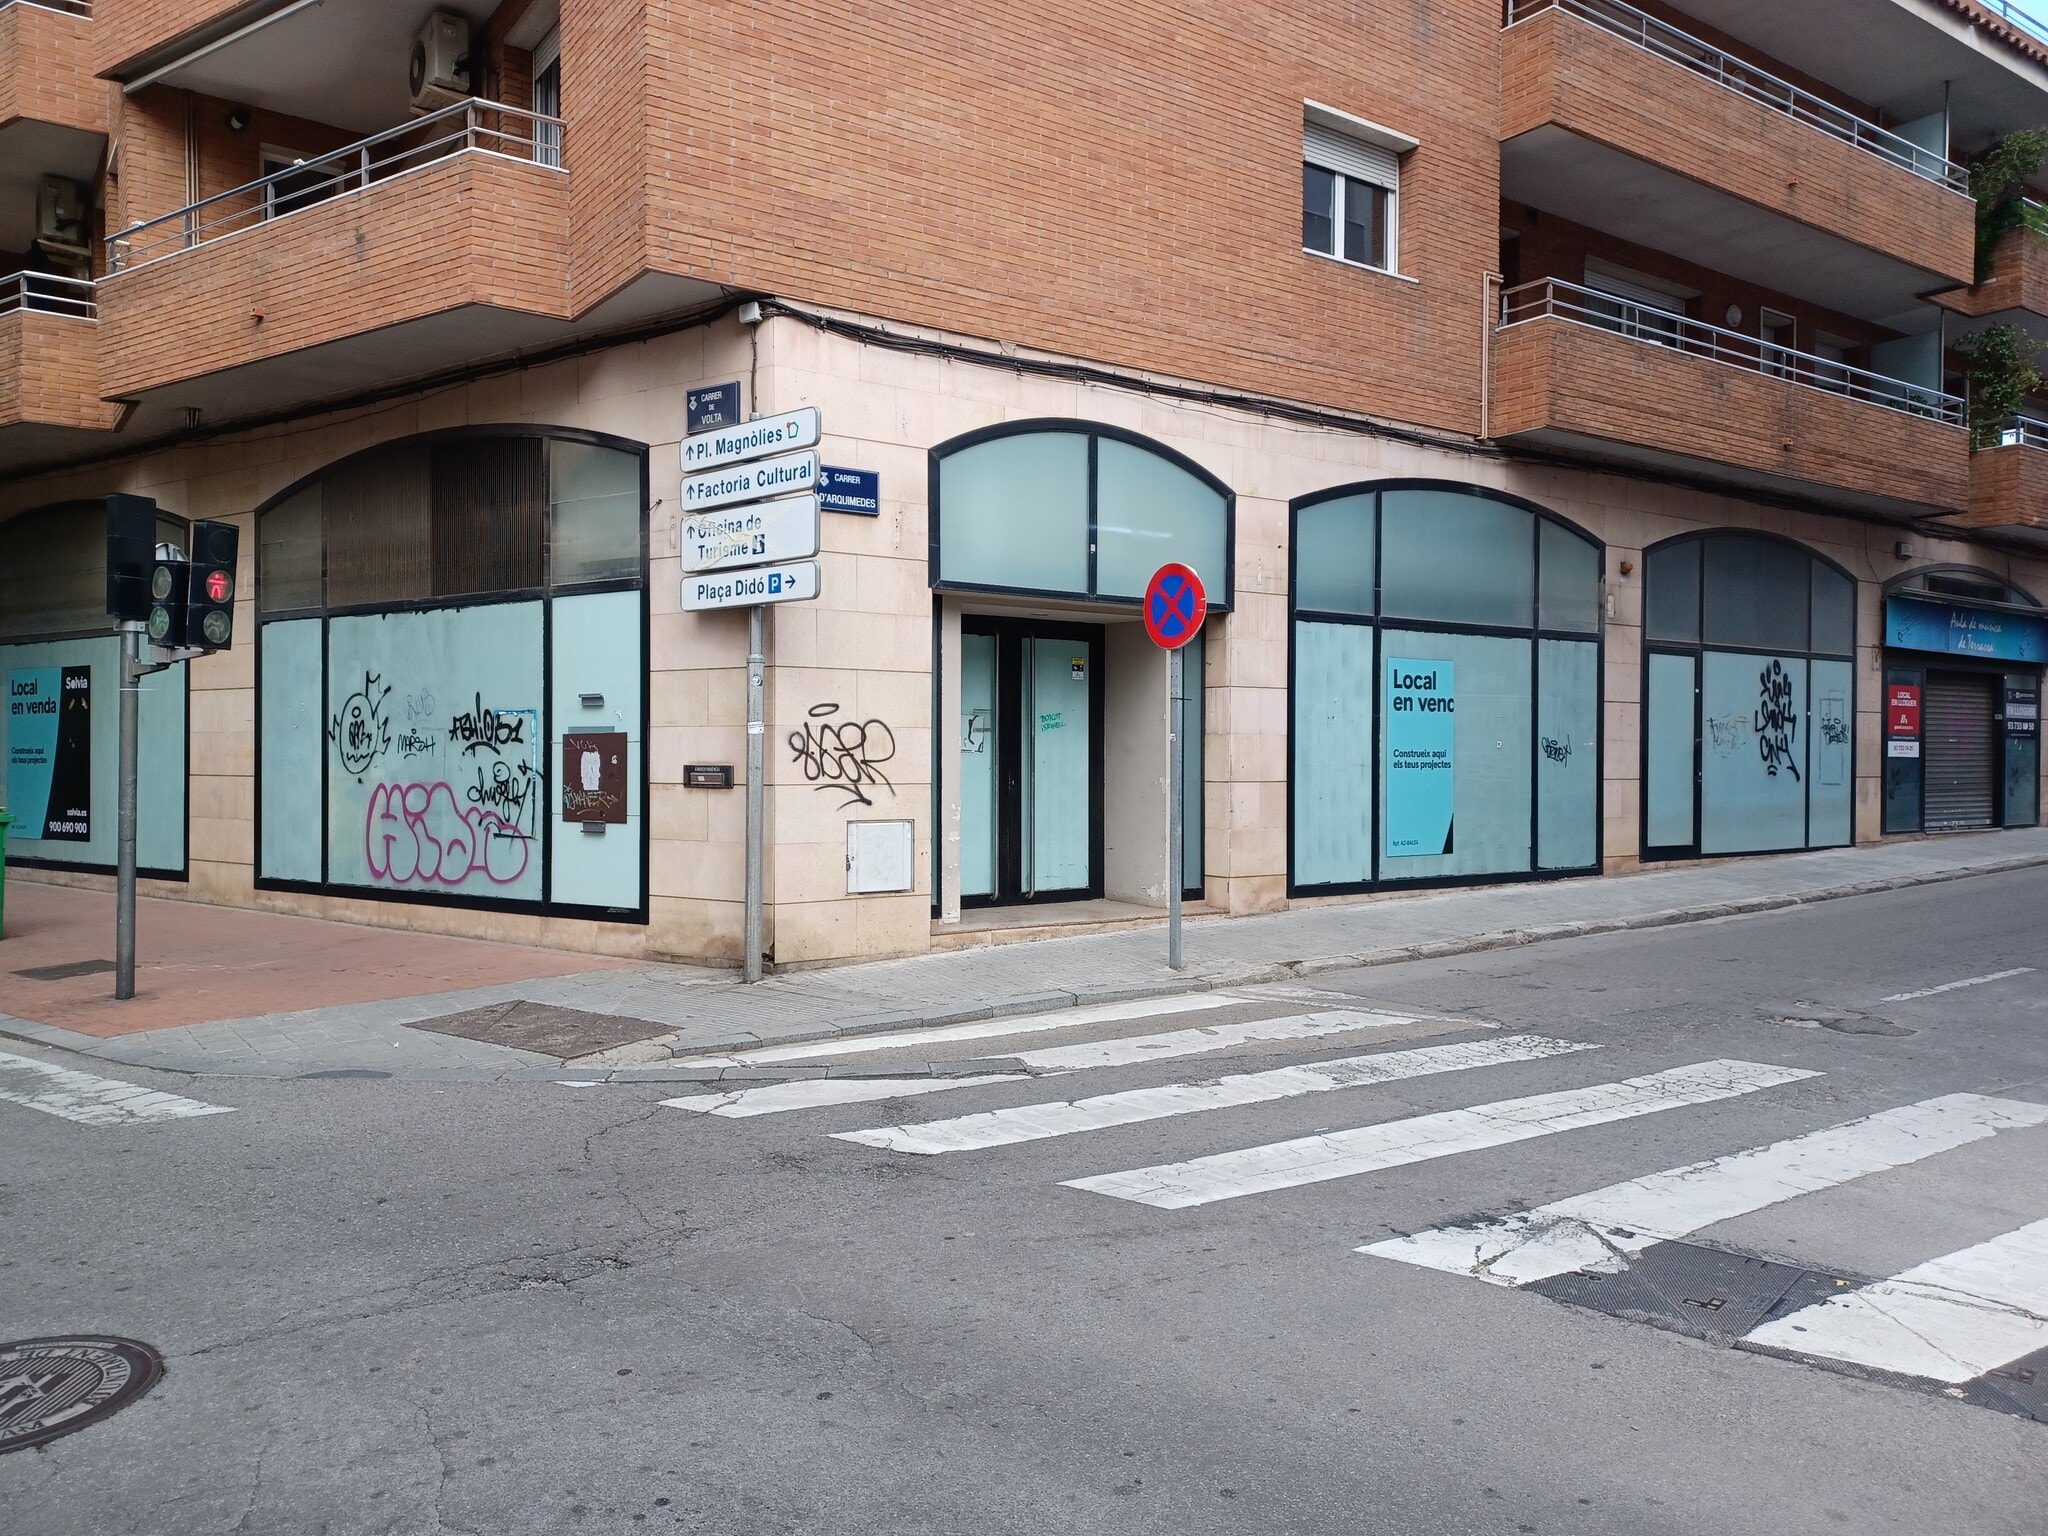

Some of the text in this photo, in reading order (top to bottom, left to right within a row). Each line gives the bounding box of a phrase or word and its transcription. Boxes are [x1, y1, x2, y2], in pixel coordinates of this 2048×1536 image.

[701, 390, 722, 402] CARRER
[708, 403, 715, 411] DE
[701, 412, 722, 425] VOLTA
[697, 428, 783, 460] Pl. Magnòlies
[697, 460, 812, 499] Factoria Cultural
[834, 472, 861, 485] CARRER
[819, 492, 876, 509] D'ARQUIMEDES
[746, 514, 762, 531] de
[697, 582, 732, 602] Plaça
[735, 578, 765, 598] Didó
[1958, 634, 1966, 649] de
[11, 677, 38, 696] Local
[65, 676, 88, 690] Solvia
[1393, 668, 1437, 690] Local
[11, 697, 57, 715] en venda
[1393, 696, 1413, 712] en
[27, 756, 47, 765] projectes
[1393, 749, 1447, 760] Construeix aquí
[1393, 760, 1451, 770] els teus projectes
[49, 821, 87, 834] 900 690 900
